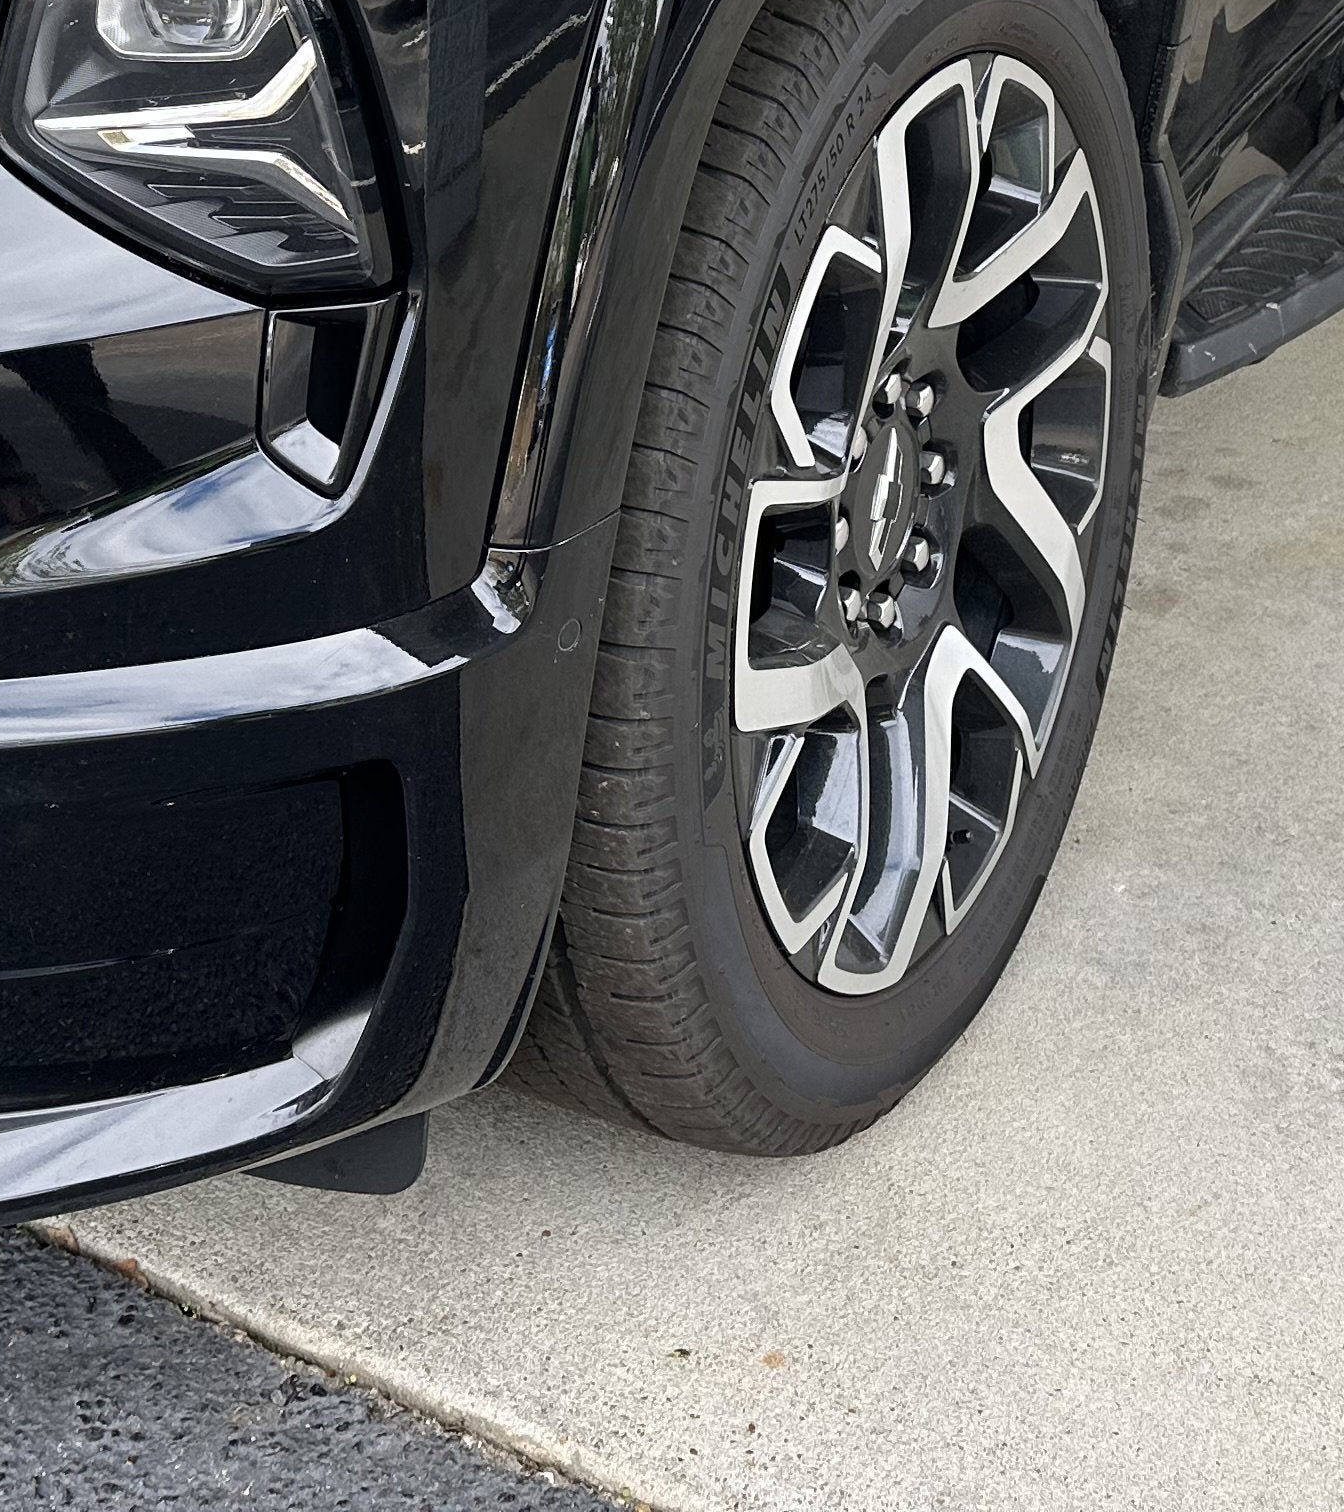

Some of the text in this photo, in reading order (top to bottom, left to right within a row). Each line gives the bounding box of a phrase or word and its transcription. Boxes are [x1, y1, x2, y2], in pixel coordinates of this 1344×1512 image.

[794, 84, 872, 245] LT275/50 R 24
[706, 288, 786, 681] MICHELIN
